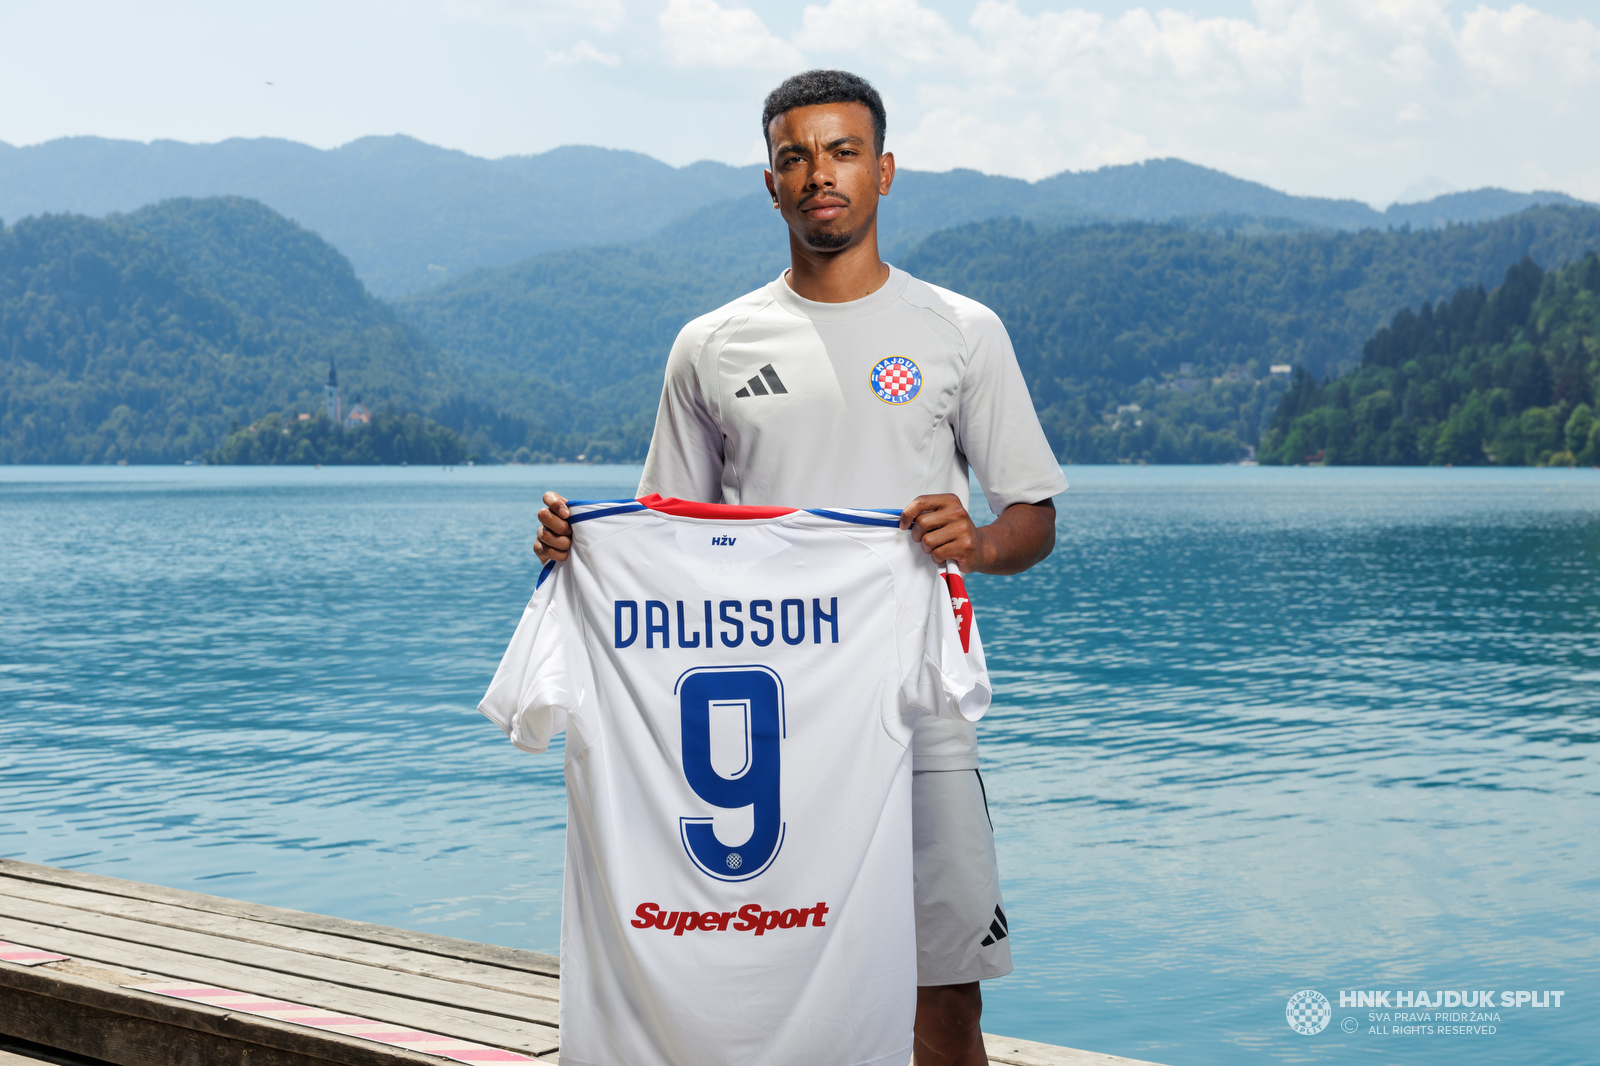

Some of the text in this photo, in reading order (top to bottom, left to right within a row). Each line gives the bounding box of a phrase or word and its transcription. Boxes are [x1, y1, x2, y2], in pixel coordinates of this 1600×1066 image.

[875, 358, 918, 374] HAJDUK
[877, 389, 909, 402] SPLIT
[711, 534, 737, 546] HŽV
[614, 597, 840, 649] DALISSON
[674, 664, 786, 883] 9
[630, 902, 830, 936] SuperSport
